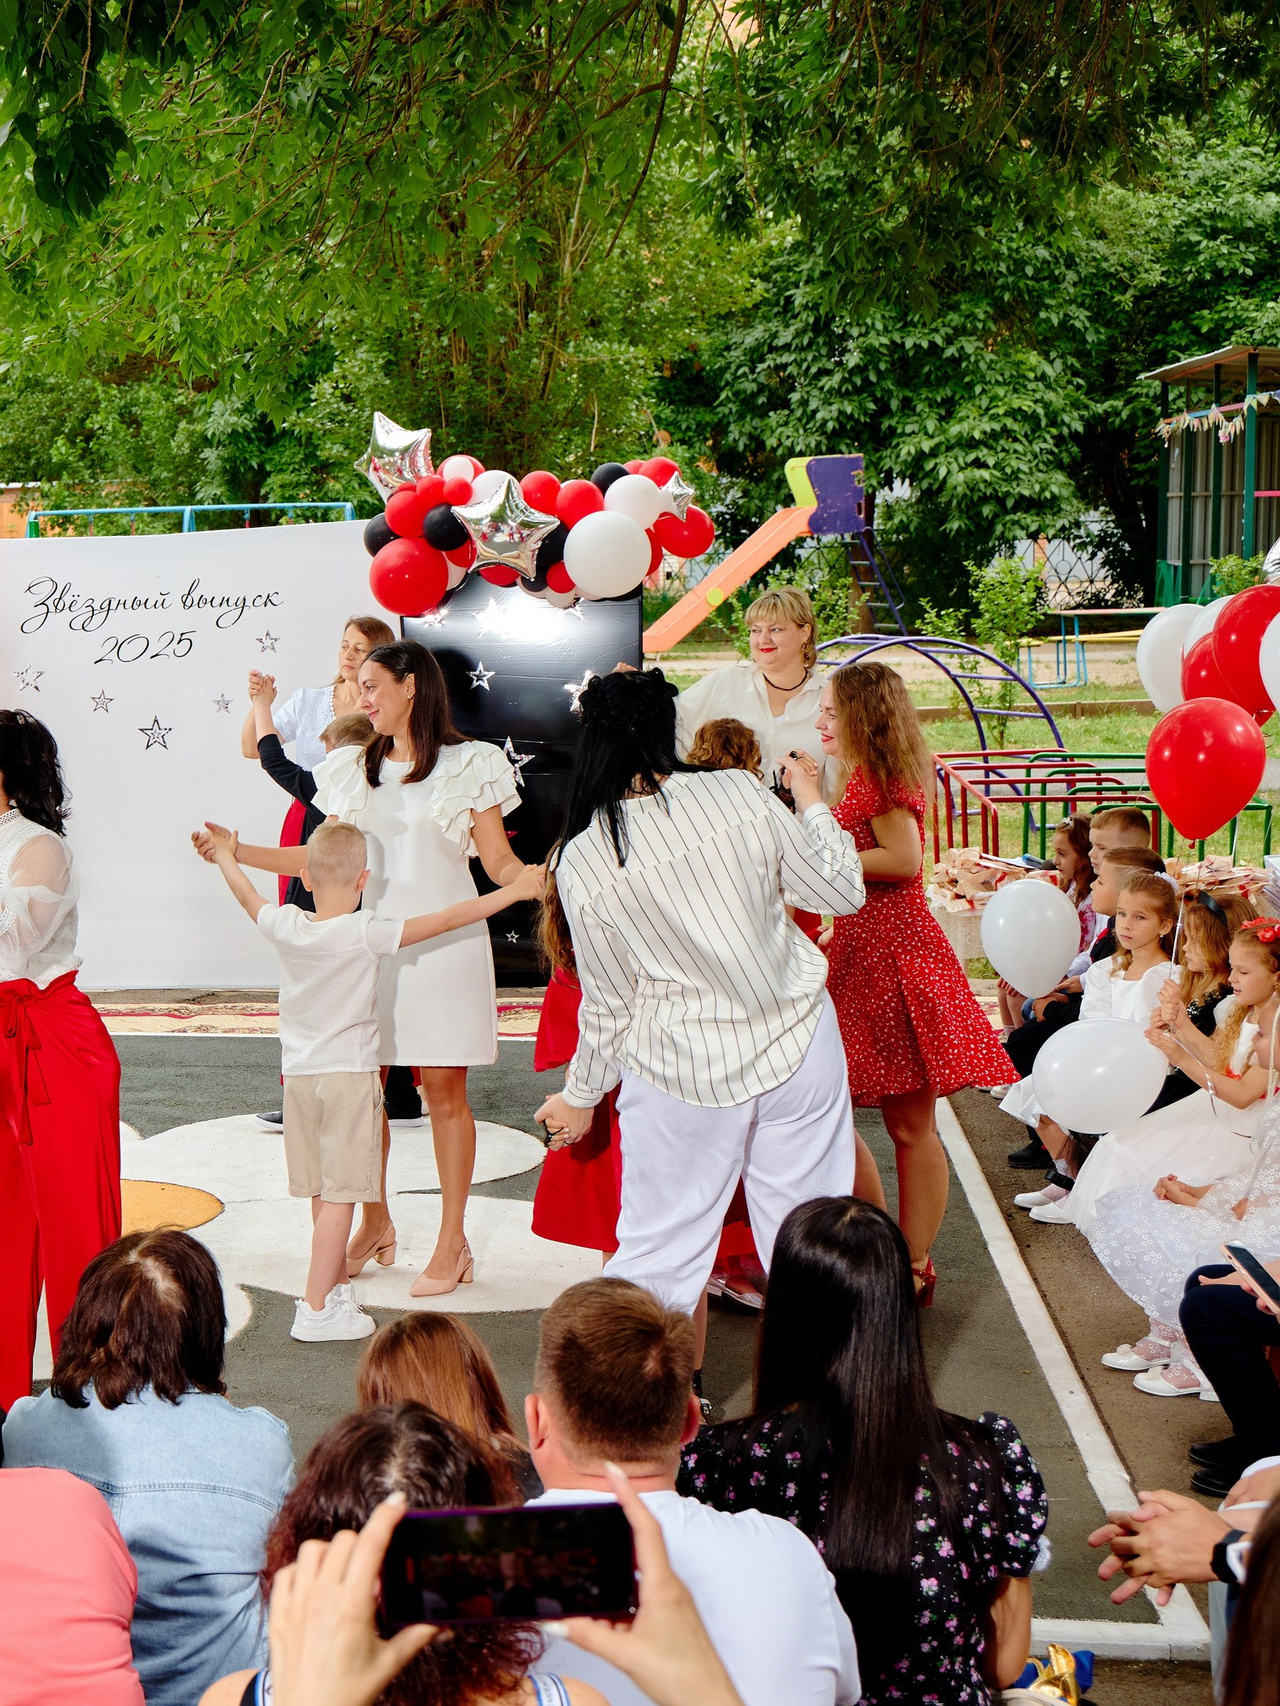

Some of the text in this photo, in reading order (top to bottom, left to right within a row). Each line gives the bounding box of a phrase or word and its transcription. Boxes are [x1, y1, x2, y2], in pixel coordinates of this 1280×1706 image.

[20, 576, 284, 634] Звёздный выпуск
[94, 631, 196, 664] 2025
